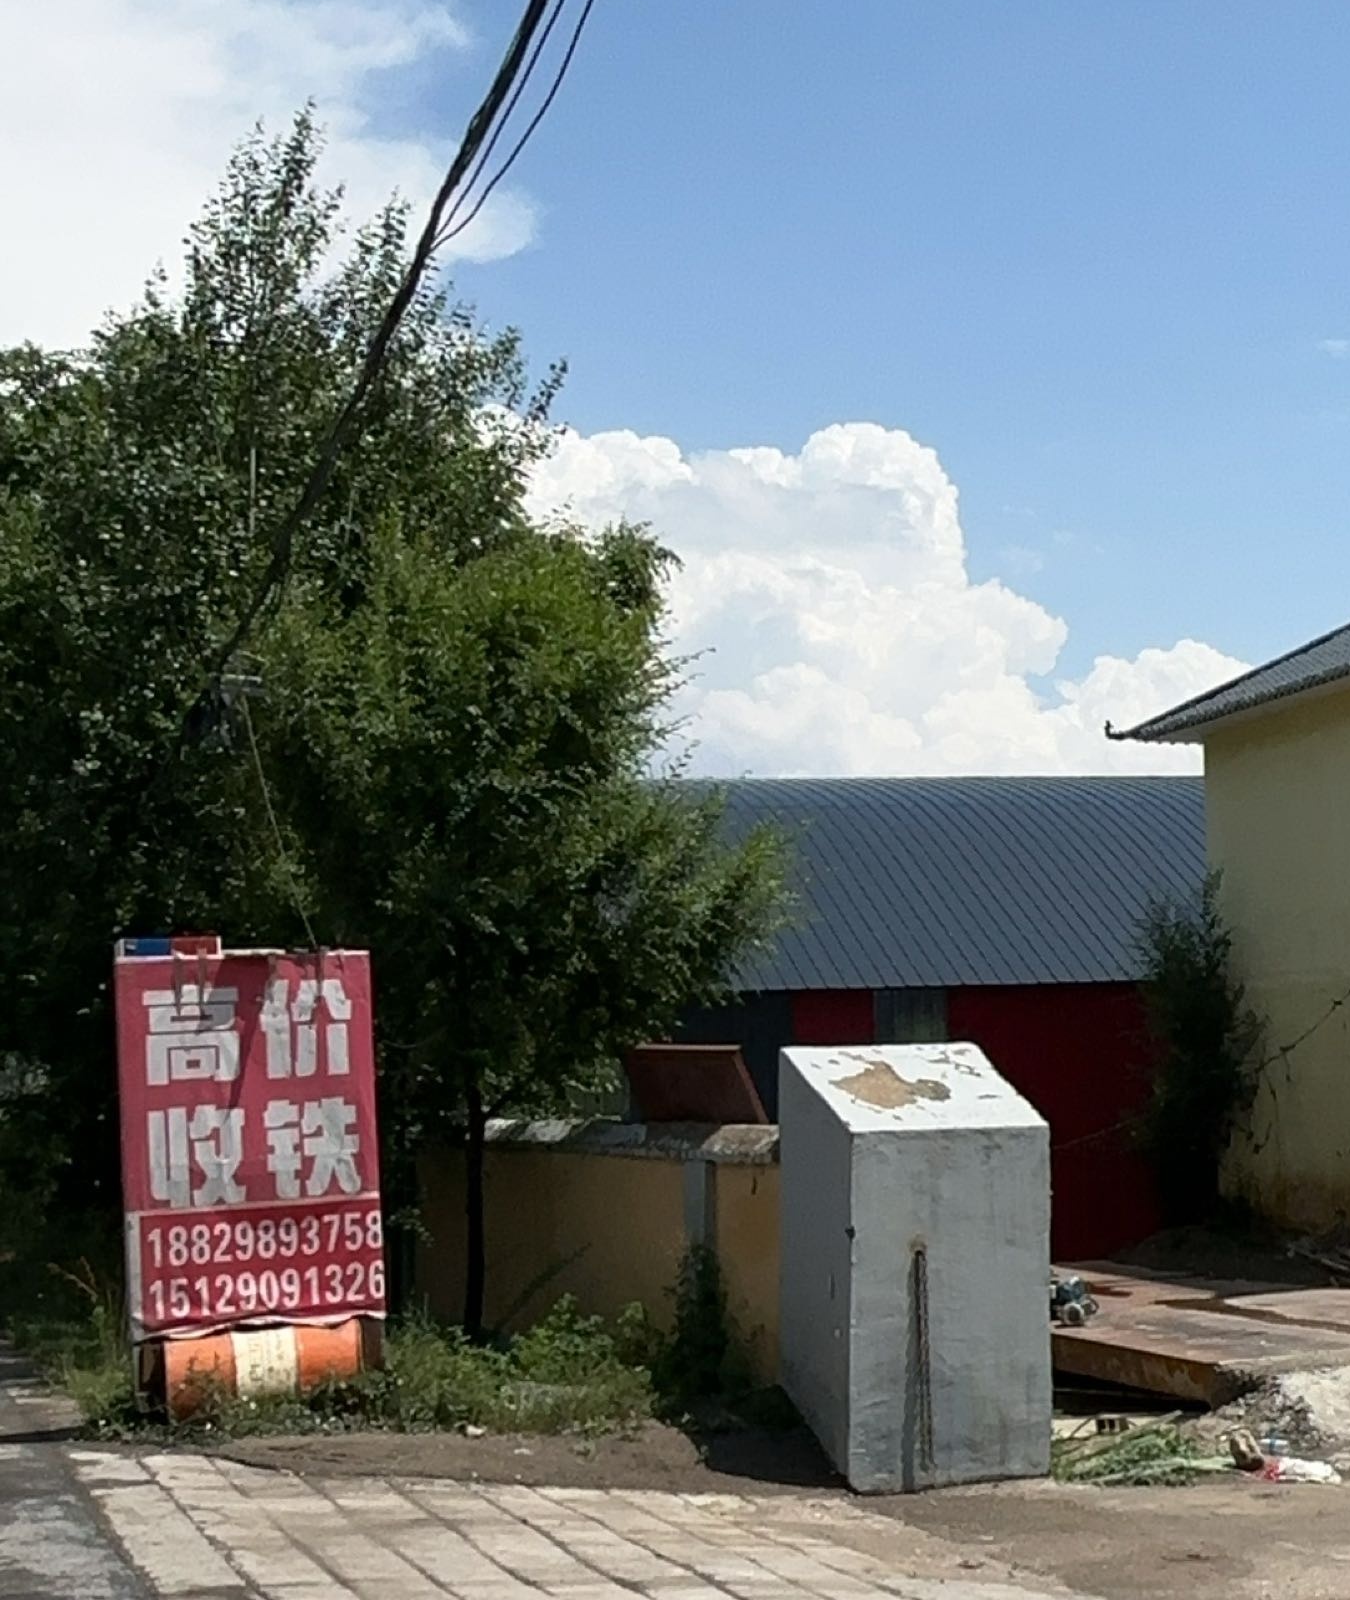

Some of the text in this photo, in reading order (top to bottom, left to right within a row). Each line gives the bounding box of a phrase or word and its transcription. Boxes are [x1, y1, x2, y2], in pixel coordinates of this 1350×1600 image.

[142, 979, 352, 1086] 高价
[147, 1097, 361, 1207] 收铁
[147, 1210, 383, 1268] 18829893758
[150, 1259, 385, 1320] 15129091326
